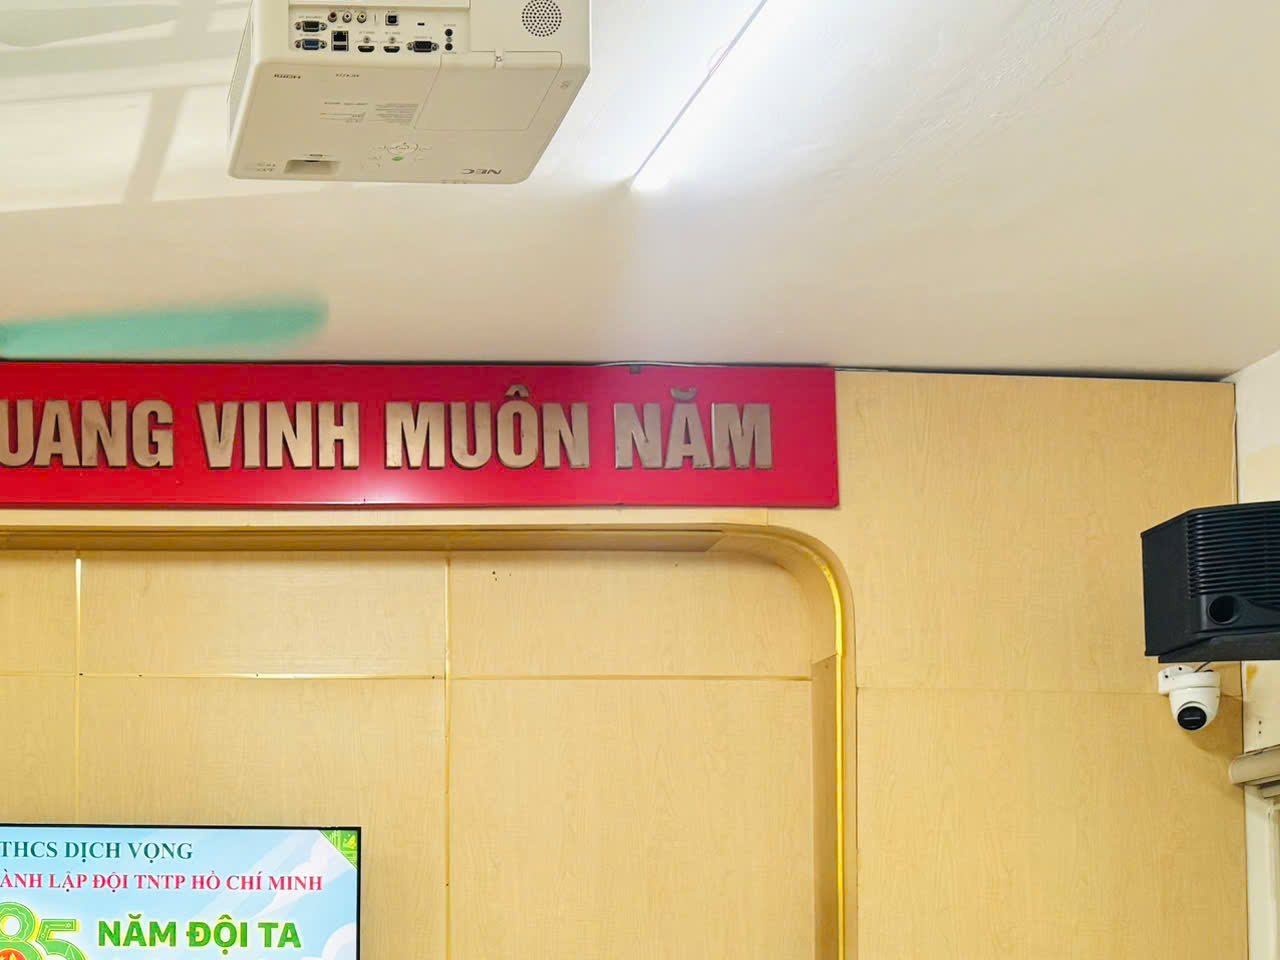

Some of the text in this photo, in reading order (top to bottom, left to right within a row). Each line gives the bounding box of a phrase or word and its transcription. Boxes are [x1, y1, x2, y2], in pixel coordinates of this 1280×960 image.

[196, 400, 359, 471] VINH
[383, 386, 590, 471] MUÔN
[614, 387, 773, 472] NĂM
[64, 842, 120, 863] DỊCH
[127, 842, 193, 863] VỌNG
[49, 871, 87, 892] LẬP
[92, 871, 128, 893] ĐỘI
[134, 874, 185, 889] TNTP
[226, 871, 262, 890] CHÍ
[268, 875, 322, 891] MINH
[98, 913, 302, 956] NĂM ĐỘI TA
